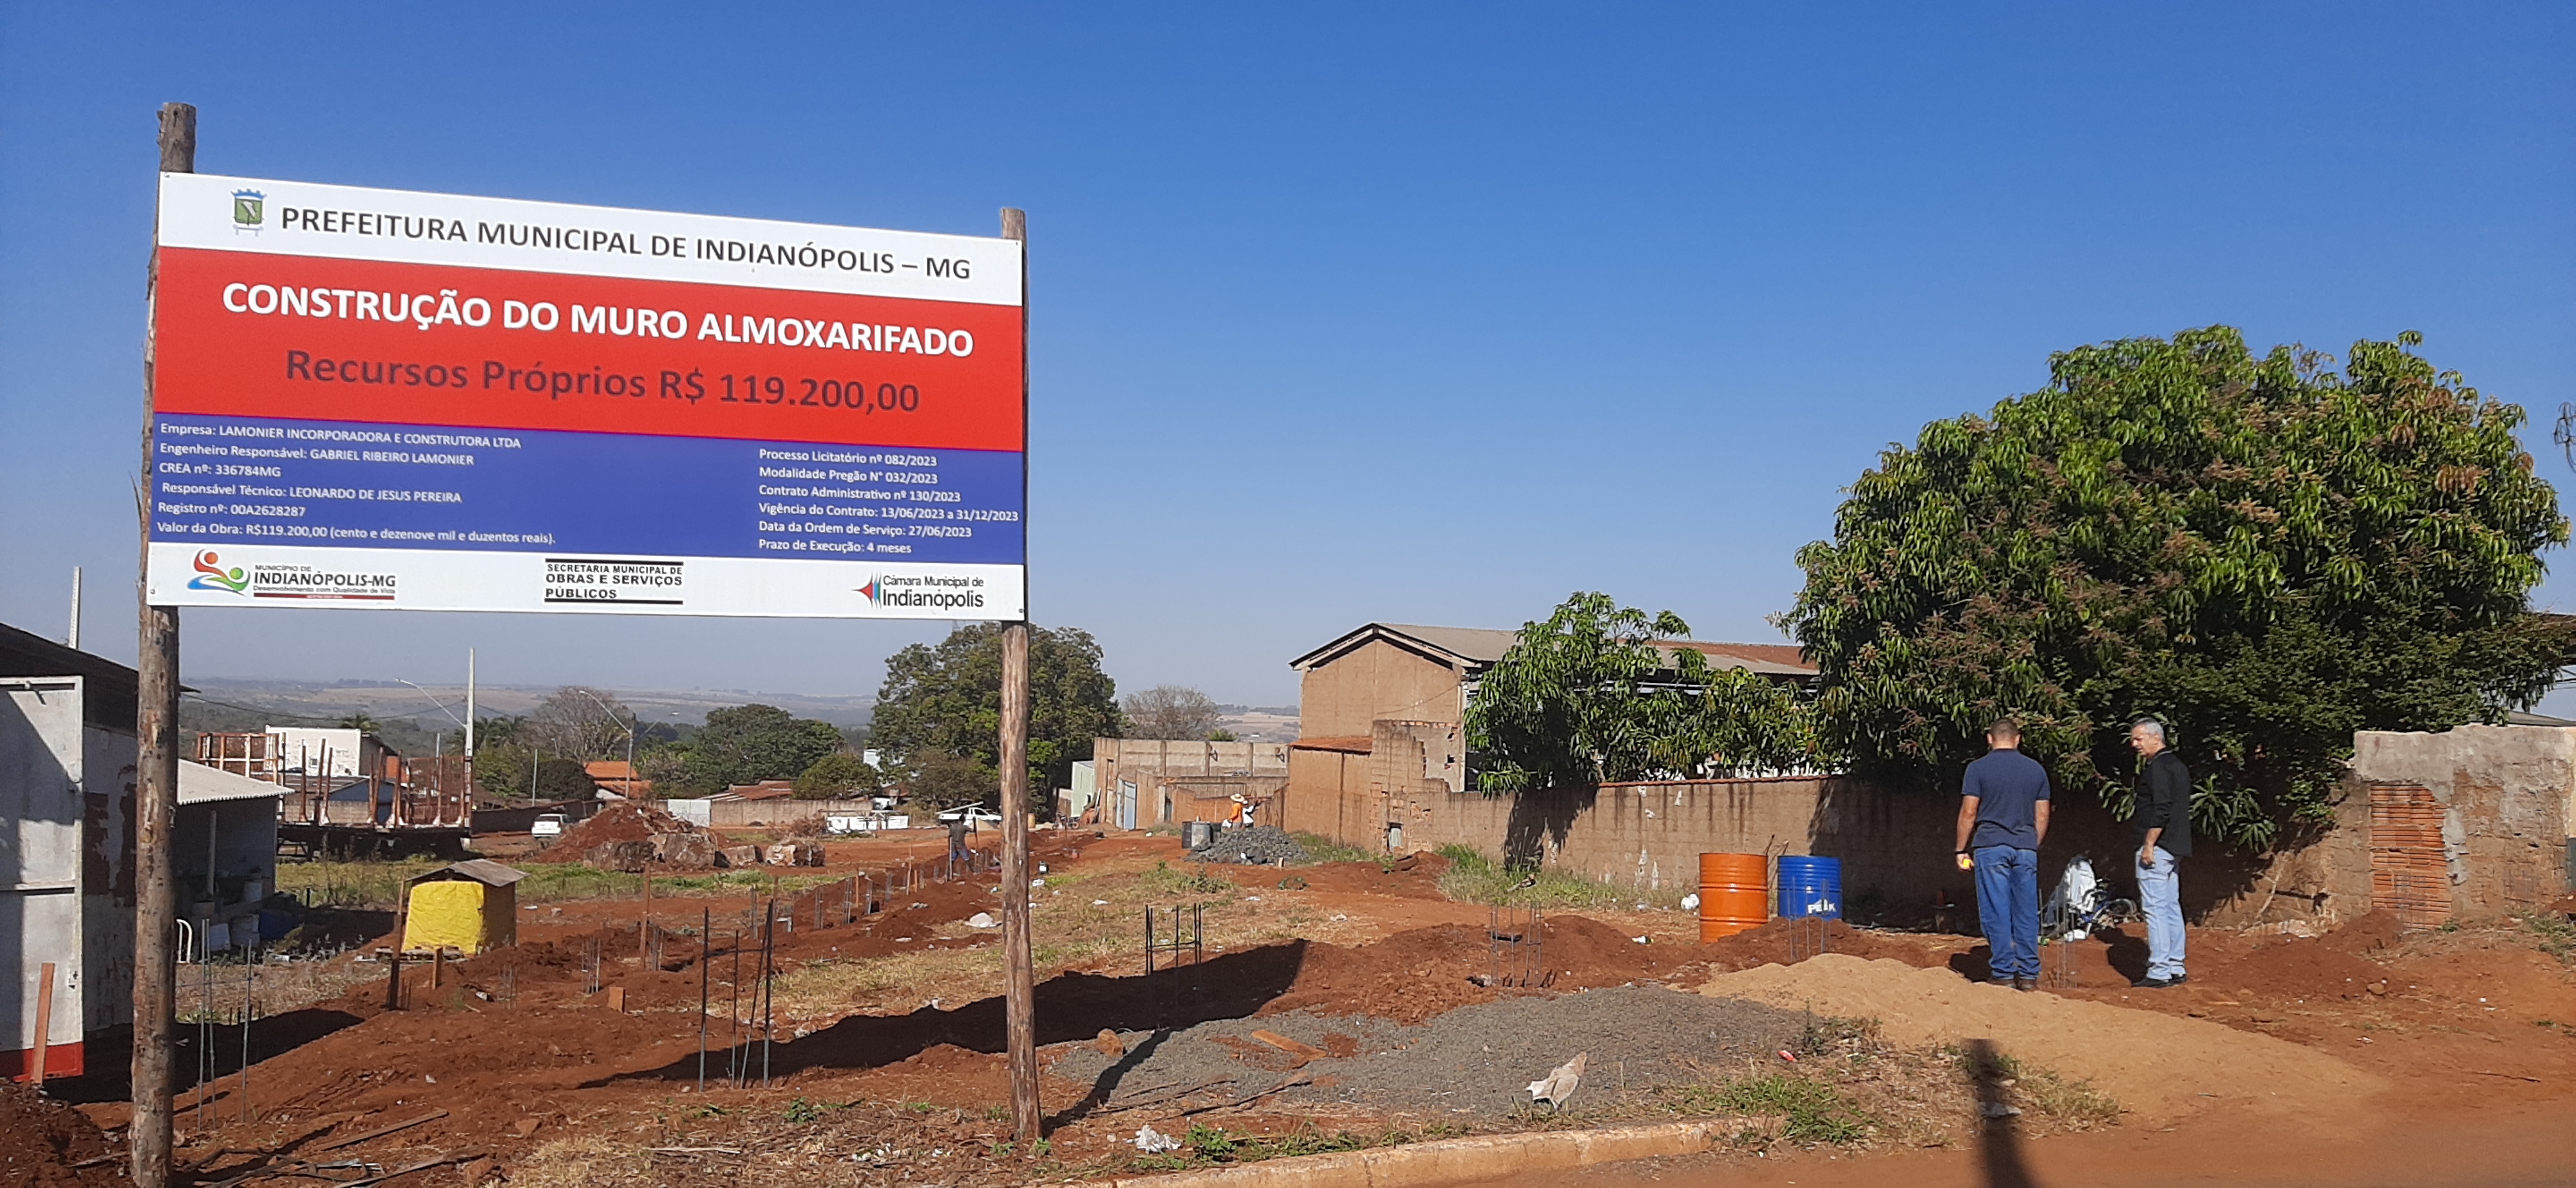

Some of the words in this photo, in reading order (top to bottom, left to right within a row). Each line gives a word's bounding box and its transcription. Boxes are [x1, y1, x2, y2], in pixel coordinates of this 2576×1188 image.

[283, 207, 467, 242] PREFEITURA
[479, 222, 641, 254] MUNICIPAL
[652, 236, 686, 258] DE
[697, 239, 894, 273] INDIANÓPOLIS
[927, 258, 969, 278] MG
[223, 282, 491, 331] CONSTRUÇÃO
[504, 300, 558, 331] DO
[572, 305, 687, 338] MURO
[697, 314, 972, 356] ALMOXARIFADO
[287, 350, 468, 388] Recursos
[484, 361, 645, 400] Próprios
[661, 368, 705, 405] R$
[721, 375, 919, 415] 119.200,00
[161, 423, 216, 436] Empresa:
[220, 426, 283, 438] LAMONIER
[287, 429, 392, 443] INCORPORADORA
[395, 434, 401, 443] E
[404, 434, 490, 446] CONSTRUTORA
[493, 437, 521, 448] LTDA
[160, 443, 227, 455] Engenheiro
[231, 446, 307, 458] Responsável:
[310, 449, 359, 461] GABRIEL
[363, 451, 409, 462] RIBEIRO
[412, 454, 474, 465] LAMONIER
[760, 448, 809, 460] Processo
[812, 451, 866, 463] Licitatório
[885, 455, 937, 466] 082/2023
[160, 463, 191, 473] CREA
[215, 465, 281, 477] 336784MG
[760, 467, 826, 479] Modalidade
[829, 470, 867, 483] Pregão
[886, 472, 938, 484] 032/2023
[162, 483, 236, 495] Responsável
[240, 485, 286, 496] Técnico:
[290, 487, 355, 499] LEONARDO
[359, 490, 374, 499] DE
[377, 490, 411, 501] JESUS
[414, 492, 462, 503] PEREIRA
[759, 485, 808, 496] Contrato
[811, 487, 891, 499] Administrativo
[910, 491, 960, 502] 130/2023
[158, 503, 207, 514] Registro
[231, 505, 305, 516] 00A2628287
[759, 503, 806, 515] Vigência
[809, 504, 824, 515] do
[826, 506, 878, 517] Contrato:
[882, 507, 945, 519] 13/06/2023
[956, 510, 1018, 521] 31/12/2023
[157, 522, 189, 532] Valor
[191, 522, 206, 533] da
[210, 524, 243, 533] Obra:
[247, 524, 328, 537] R$119.200,00
[330, 527, 368, 539] (cento
[381, 529, 435, 540] dezenove
[438, 531, 455, 540] mil
[468, 531, 519, 542] duzentos
[522, 533, 555, 544] reais).
[759, 521, 785, 531] Data
[788, 522, 802, 532] da
[805, 522, 843, 533] Ordem
[846, 524, 860, 533] de
[863, 524, 905, 537] Serviço:
[909, 526, 972, 537] 27/06/2023
[759, 539, 790, 550] Prazo
[793, 540, 807, 550] de
[810, 541, 864, 553] Execução:
[867, 542, 875, 551] 4
[548, 564, 609, 573] SECRETARIA
[613, 566, 667, 574] MUNICIPAL
[254, 571, 396, 587] INDIANÓPOLIS-MG
[546, 574, 594, 583] OBRAS
[600, 575, 607, 584] E
[612, 575, 682, 588] SERVIÇOS
[882, 575, 921, 586] Câmara
[925, 577, 969, 588] Municipal
[972, 578, 983, 586] de
[545, 586, 617, 599] PÚBLICOS
[882, 589, 984, 610] Indianópolis
